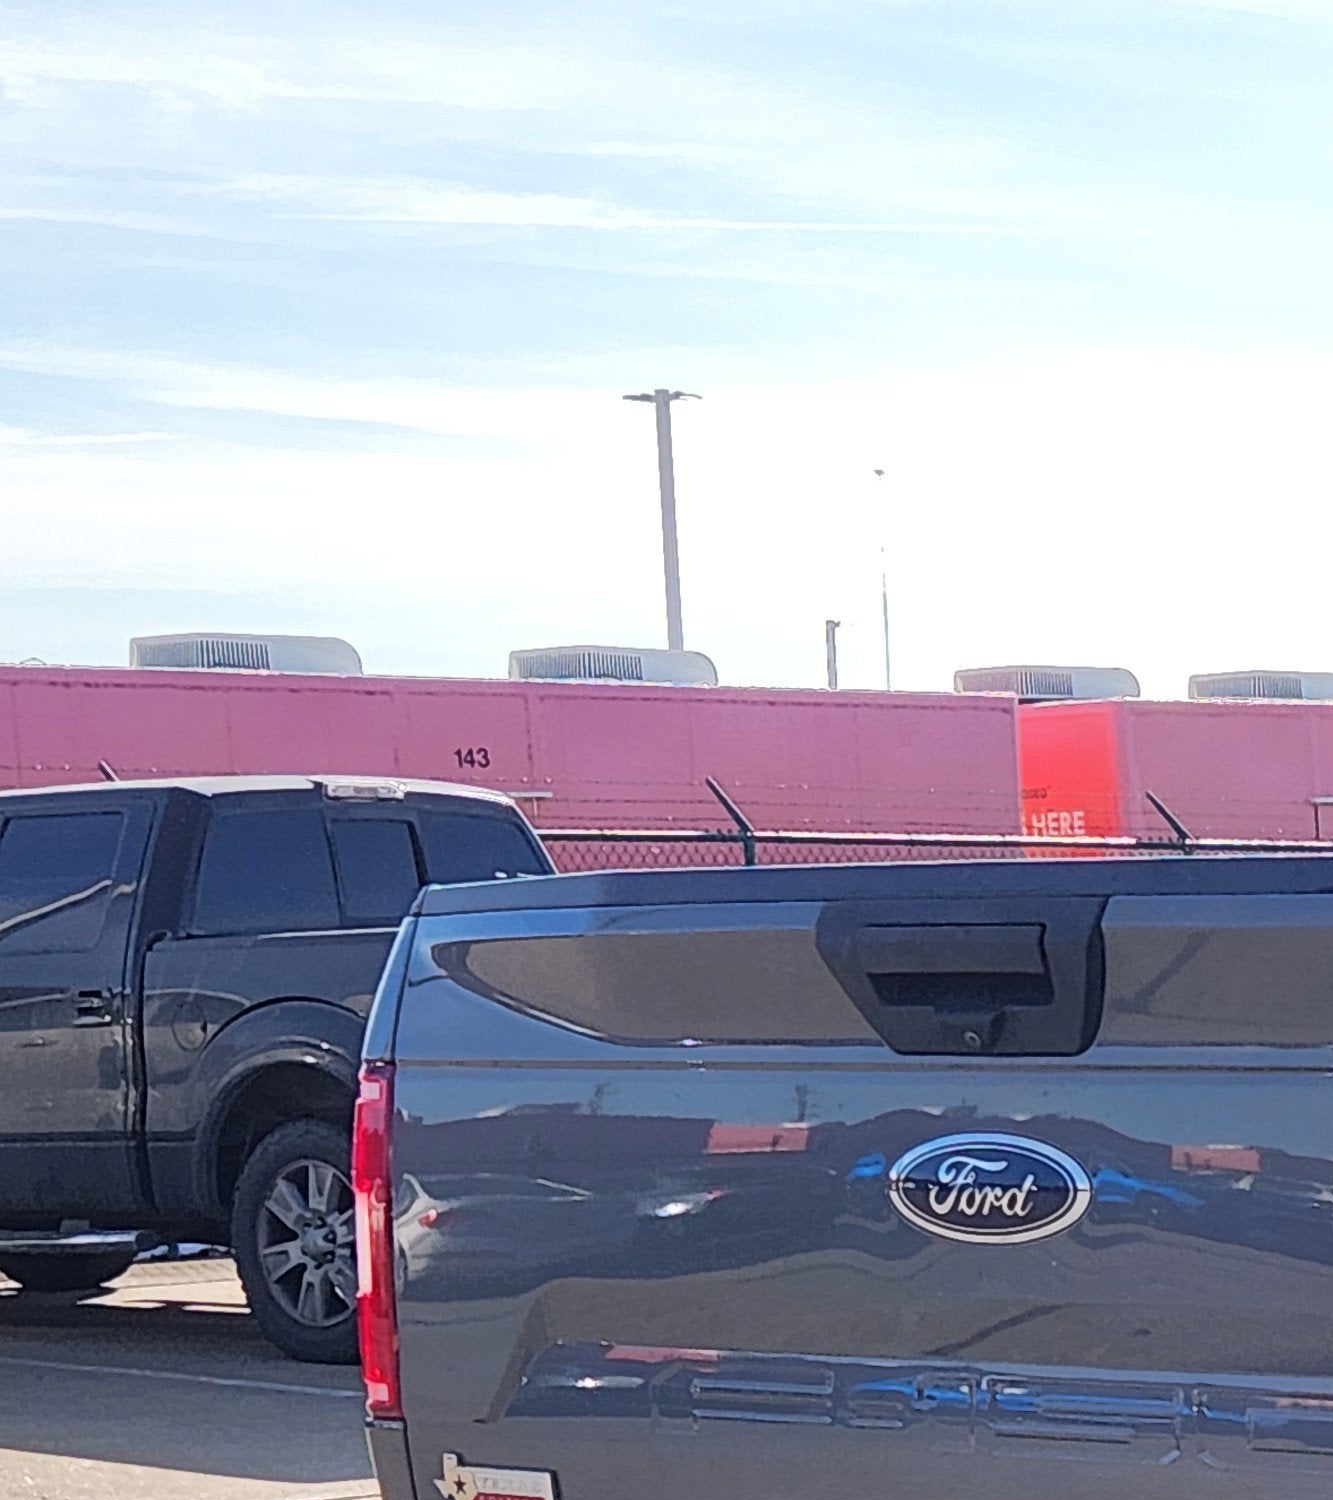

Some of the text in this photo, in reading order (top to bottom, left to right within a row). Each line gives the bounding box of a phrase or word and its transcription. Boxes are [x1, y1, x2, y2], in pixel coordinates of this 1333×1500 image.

[453, 747, 491, 769] 143
[1031, 810, 1086, 837] HERE
[928, 1155, 1039, 1217] Ford
